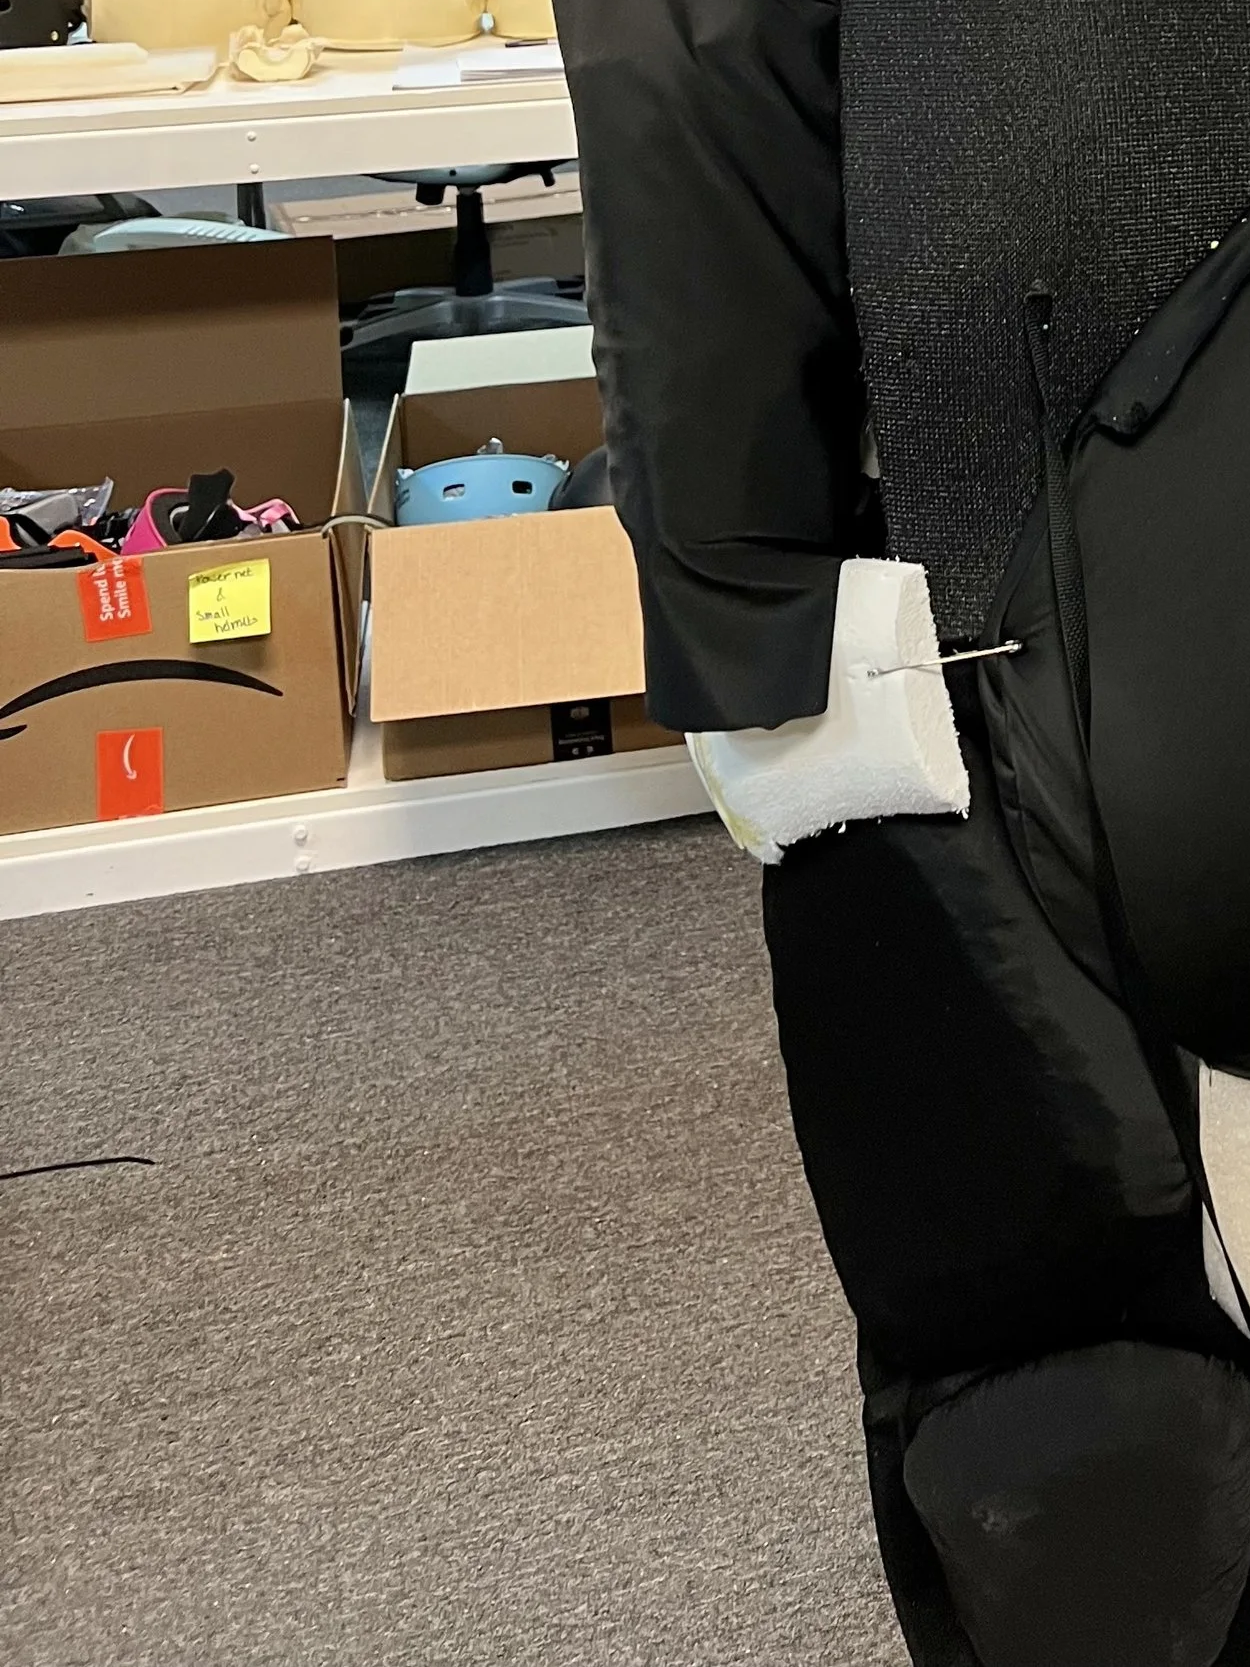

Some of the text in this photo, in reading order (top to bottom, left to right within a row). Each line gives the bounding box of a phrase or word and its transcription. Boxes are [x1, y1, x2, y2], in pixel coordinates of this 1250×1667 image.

[234, 567, 253, 579] net
[94, 578, 115, 622] Spend
[112, 579, 131, 620] Smile
